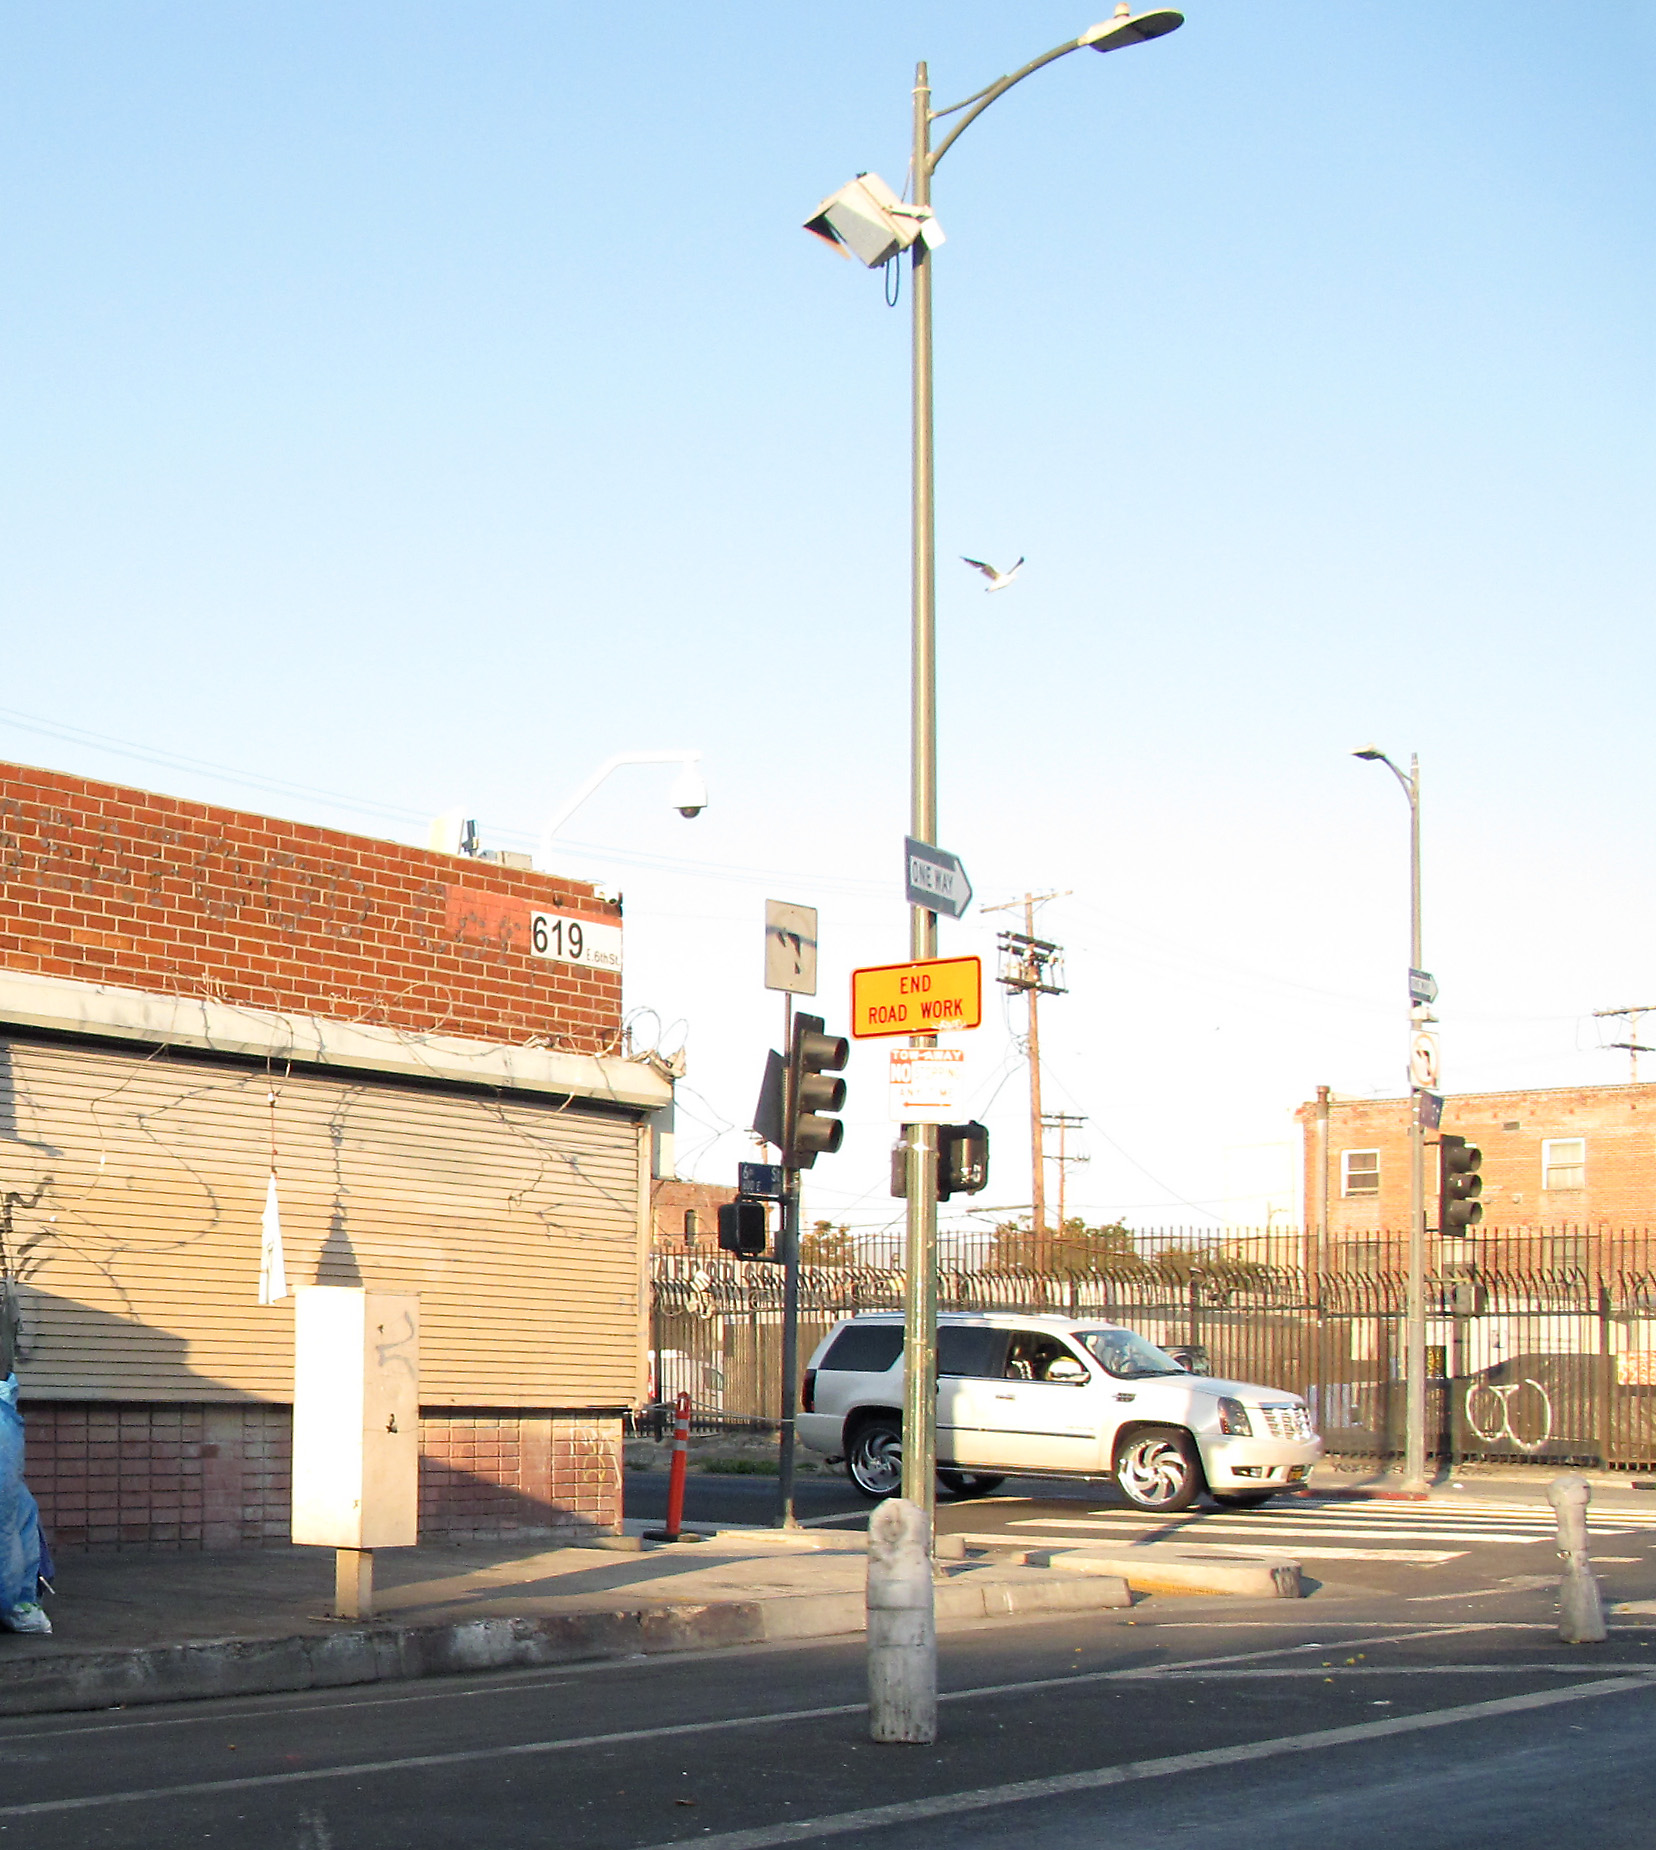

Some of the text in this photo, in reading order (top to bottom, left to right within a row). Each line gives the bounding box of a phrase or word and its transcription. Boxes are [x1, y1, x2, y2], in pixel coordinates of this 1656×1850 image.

[912, 861, 954, 895] ONE WAY
[532, 916, 583, 959] 619
[900, 974, 931, 994] END
[868, 998, 964, 1024] ROAD WORK
[891, 1063, 911, 1082] NO
